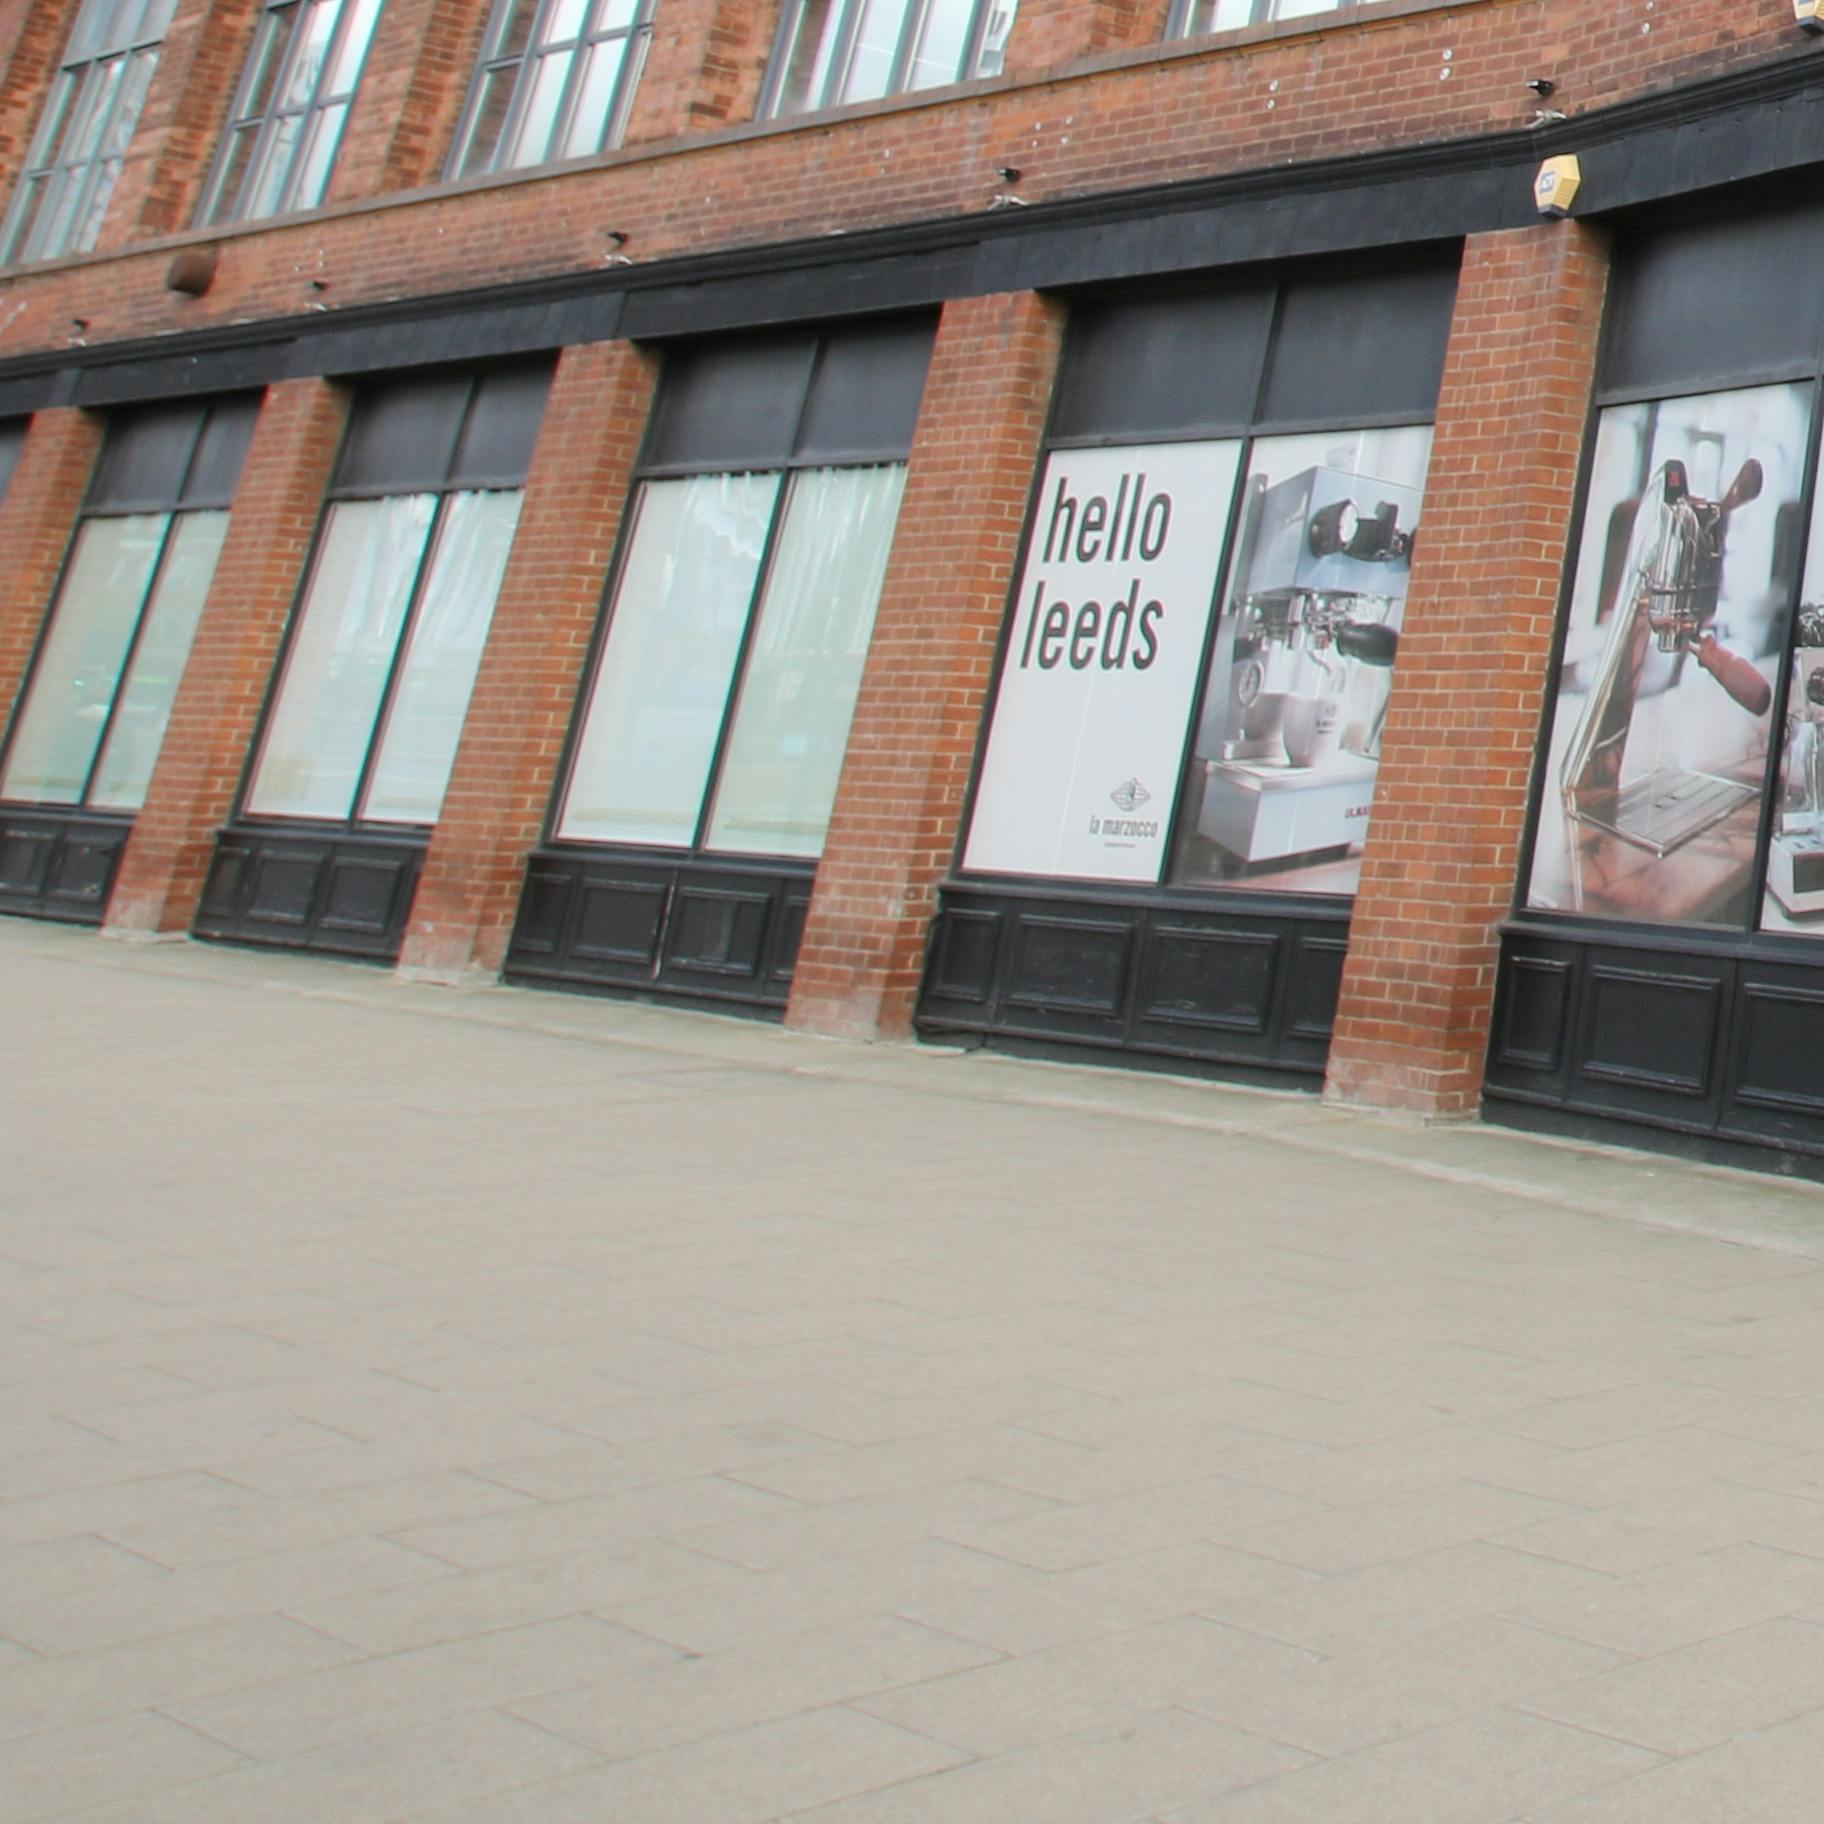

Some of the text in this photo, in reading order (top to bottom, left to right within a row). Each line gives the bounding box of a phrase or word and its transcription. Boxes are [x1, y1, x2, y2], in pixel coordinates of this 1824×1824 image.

[1042, 473, 1173, 564] hello
[1019, 578, 1164, 671] leeds
[1102, 819, 1159, 838] marzocco
